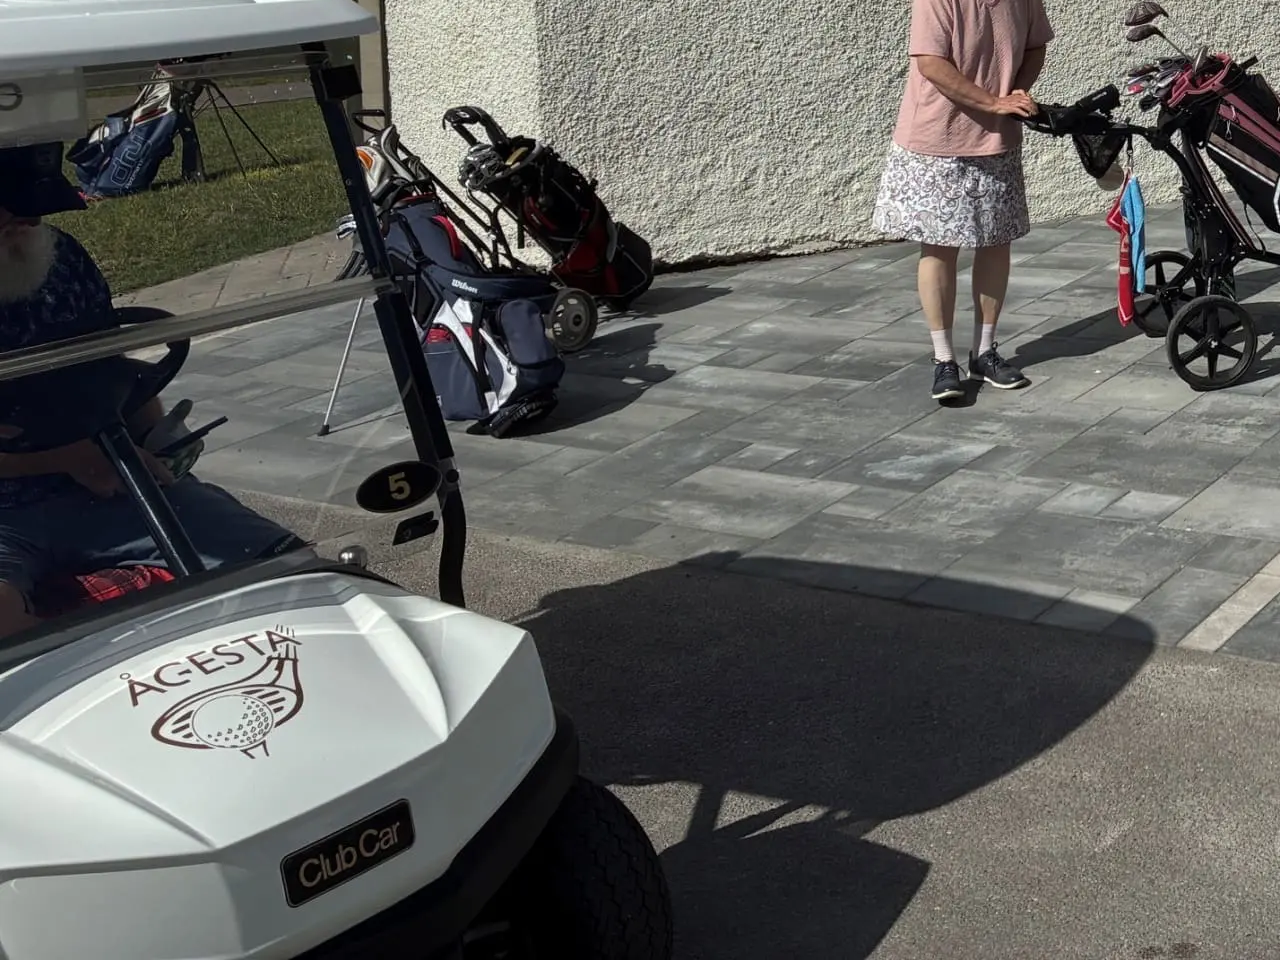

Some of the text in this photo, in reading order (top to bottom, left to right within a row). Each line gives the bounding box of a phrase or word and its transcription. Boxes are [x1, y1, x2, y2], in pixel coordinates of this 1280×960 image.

[451, 279, 478, 294] Wilson
[388, 471, 411, 500] 5
[120, 630, 302, 707] ÅGESTA
[299, 821, 400, 887] Club Car
